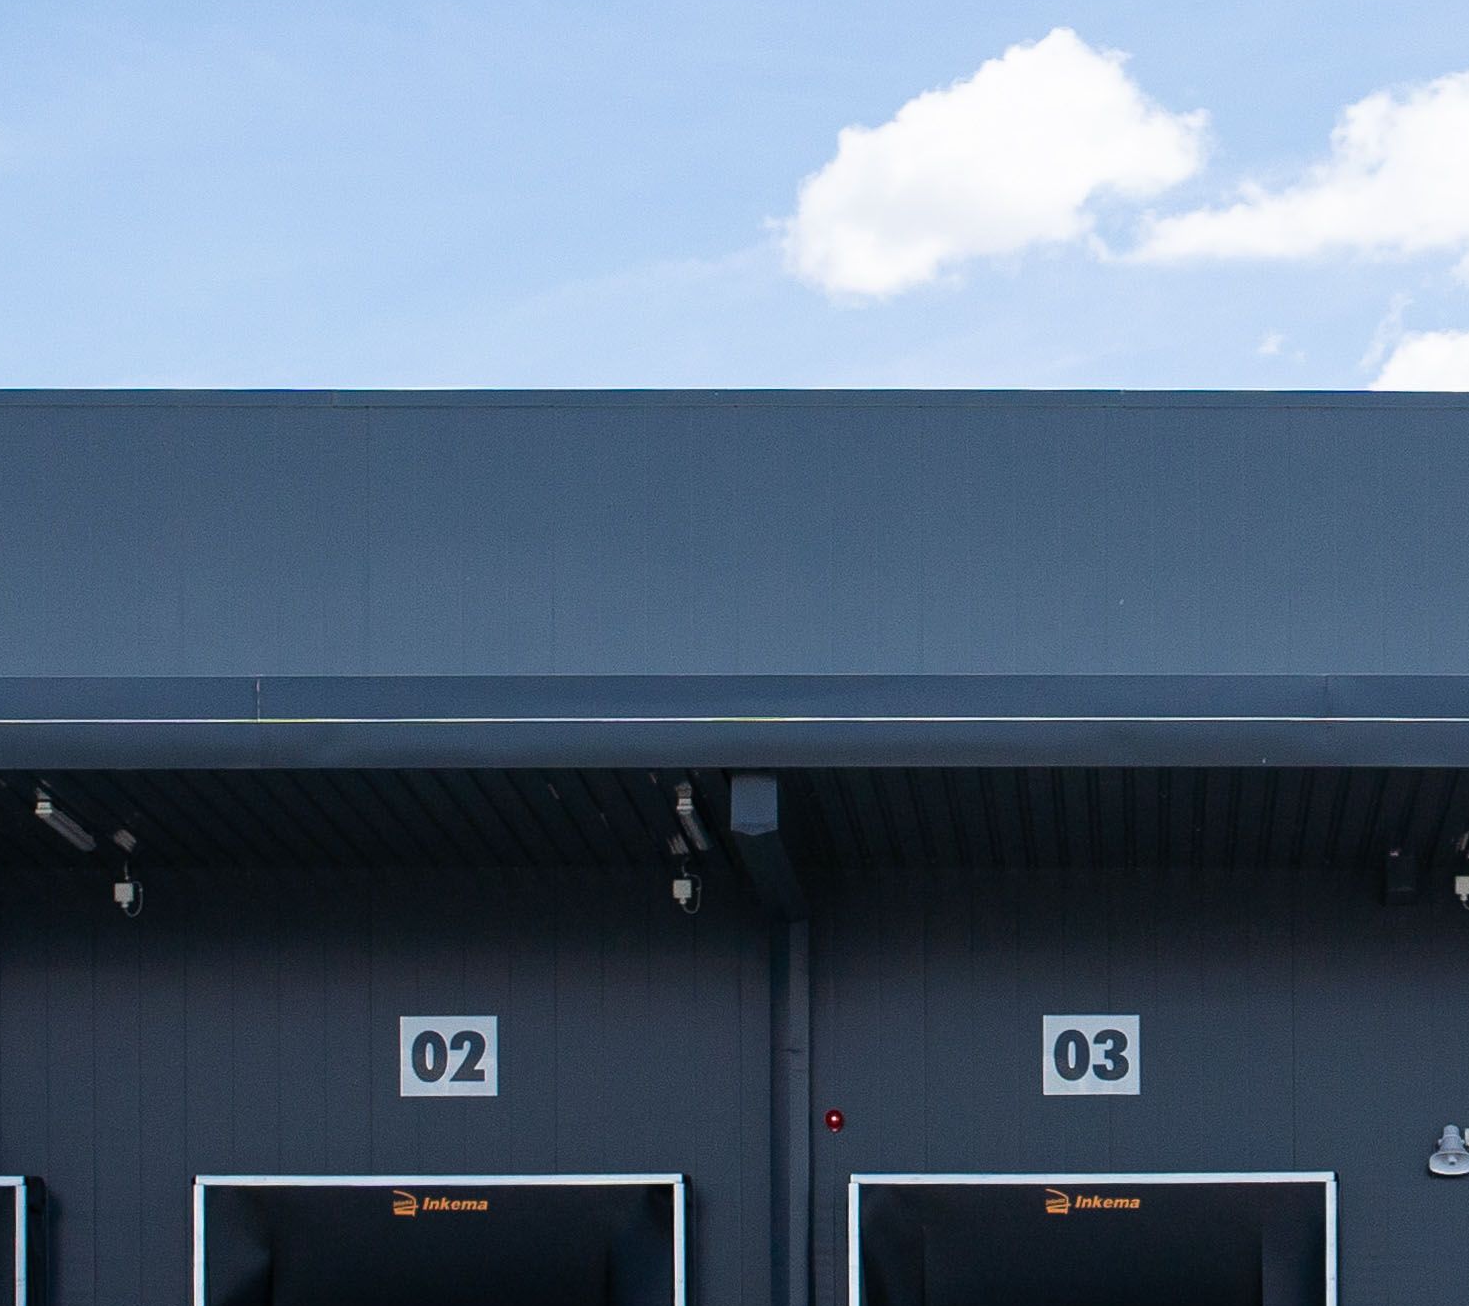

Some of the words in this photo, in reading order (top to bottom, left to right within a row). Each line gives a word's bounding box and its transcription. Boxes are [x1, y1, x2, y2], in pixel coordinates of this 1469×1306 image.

[411, 1030, 486, 1083] 02
[1053, 1028, 1130, 1081] 03
[422, 1197, 488, 1212] Inkema
[1074, 1194, 1141, 1208] Inkema
